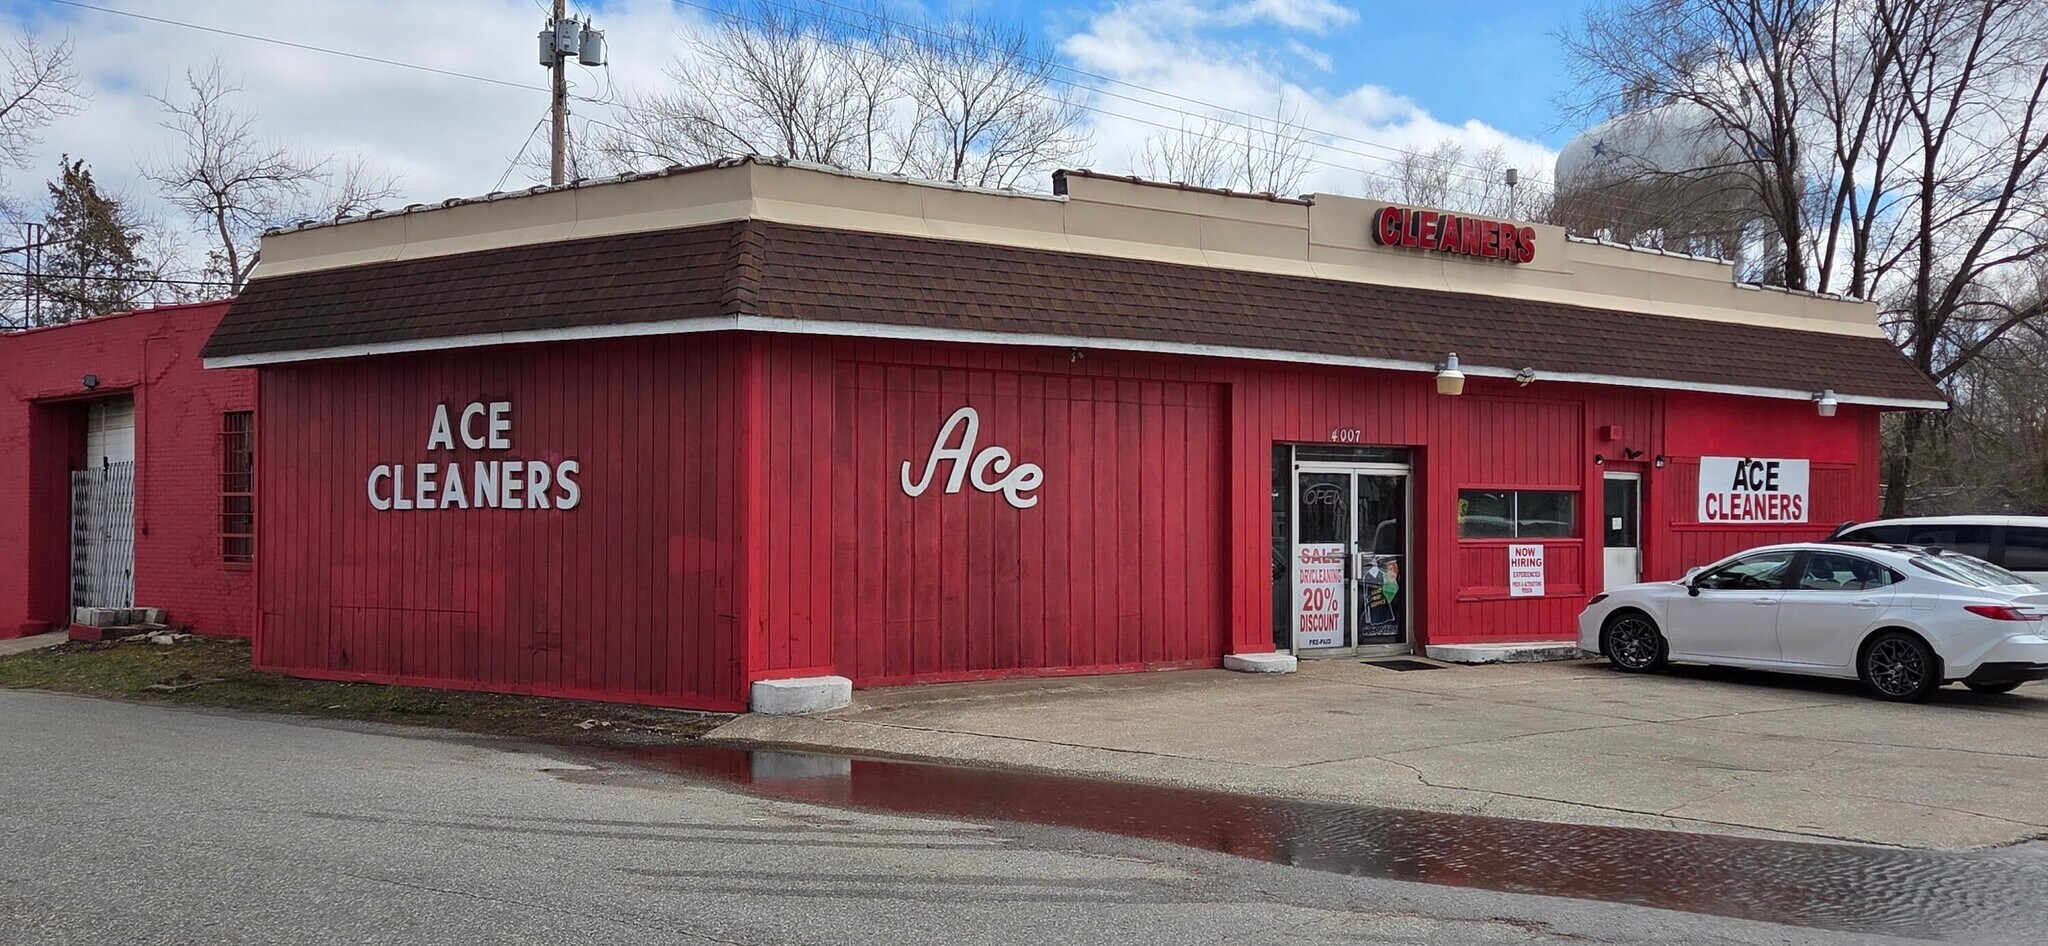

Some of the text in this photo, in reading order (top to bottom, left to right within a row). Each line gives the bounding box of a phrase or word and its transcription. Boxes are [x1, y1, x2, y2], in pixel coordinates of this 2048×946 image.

[1375, 206, 1536, 263] CLEANERS
[427, 402, 511, 450] ACE
[1331, 429, 1361, 443] 4007
[901, 406, 1044, 509] Ace
[367, 460, 581, 510] CLEANERS
[1732, 460, 1779, 491] ACE
[1705, 493, 1802, 521] CLEANERS
[1301, 548, 1340, 564] SALE
[1511, 558, 1542, 567] HIRING
[1515, 548, 1535, 557] NOW
[1300, 569, 1341, 583] DRYCLEANING
[1303, 587, 1338, 612] 20%
[1300, 613, 1339, 632] DISCOUNT
